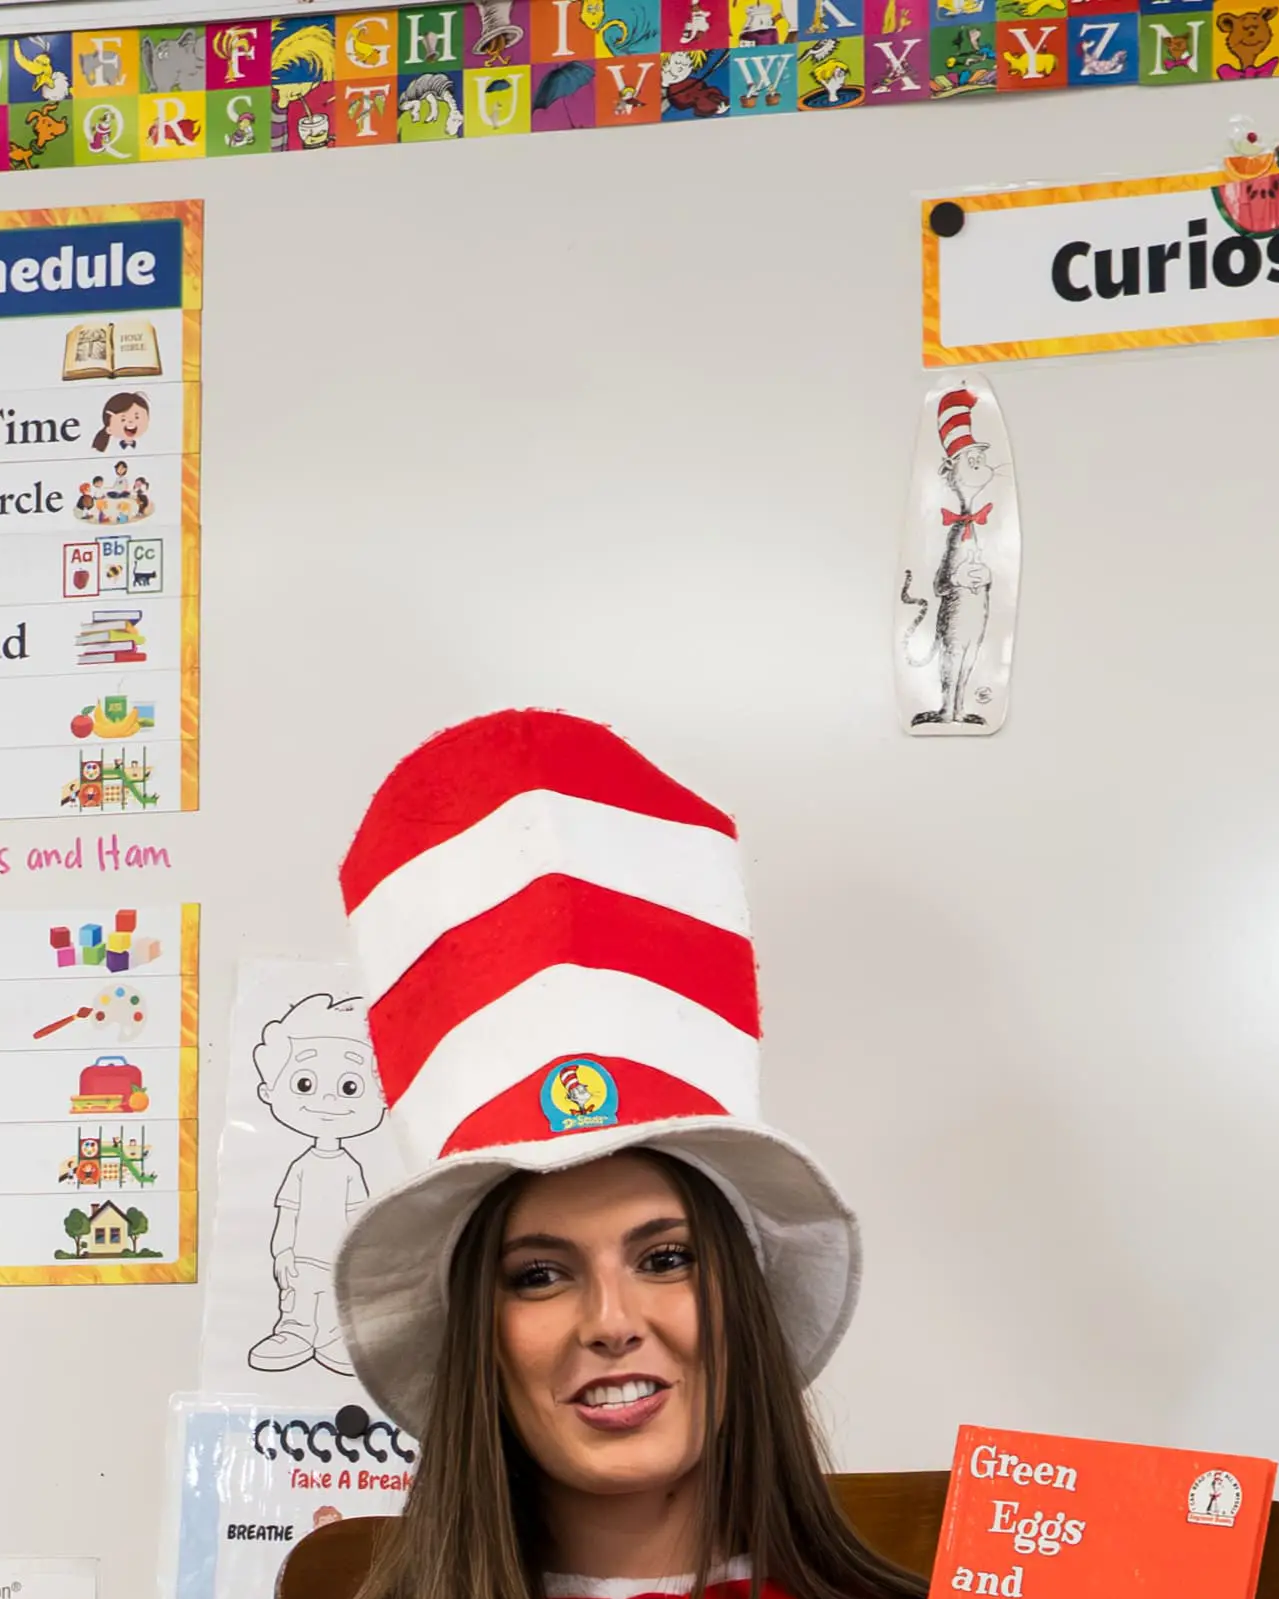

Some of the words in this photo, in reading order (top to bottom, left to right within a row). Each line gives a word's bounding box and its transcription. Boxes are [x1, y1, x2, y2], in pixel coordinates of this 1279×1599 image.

[71, 548, 94, 564] Aa
[102, 541, 125, 556] Bb
[133, 545, 156, 560] Cc
[26, 837, 83, 871] and
[97, 833, 172, 872] Ham
[290, 1468, 333, 1490] Take
[338, 1470, 352, 1490] A
[357, 1469, 414, 1493] Break
[969, 1444, 1079, 1492] Green
[227, 1523, 295, 1542] BREATHE
[987, 1499, 1087, 1556] Eggs
[950, 1564, 1024, 1599] and
